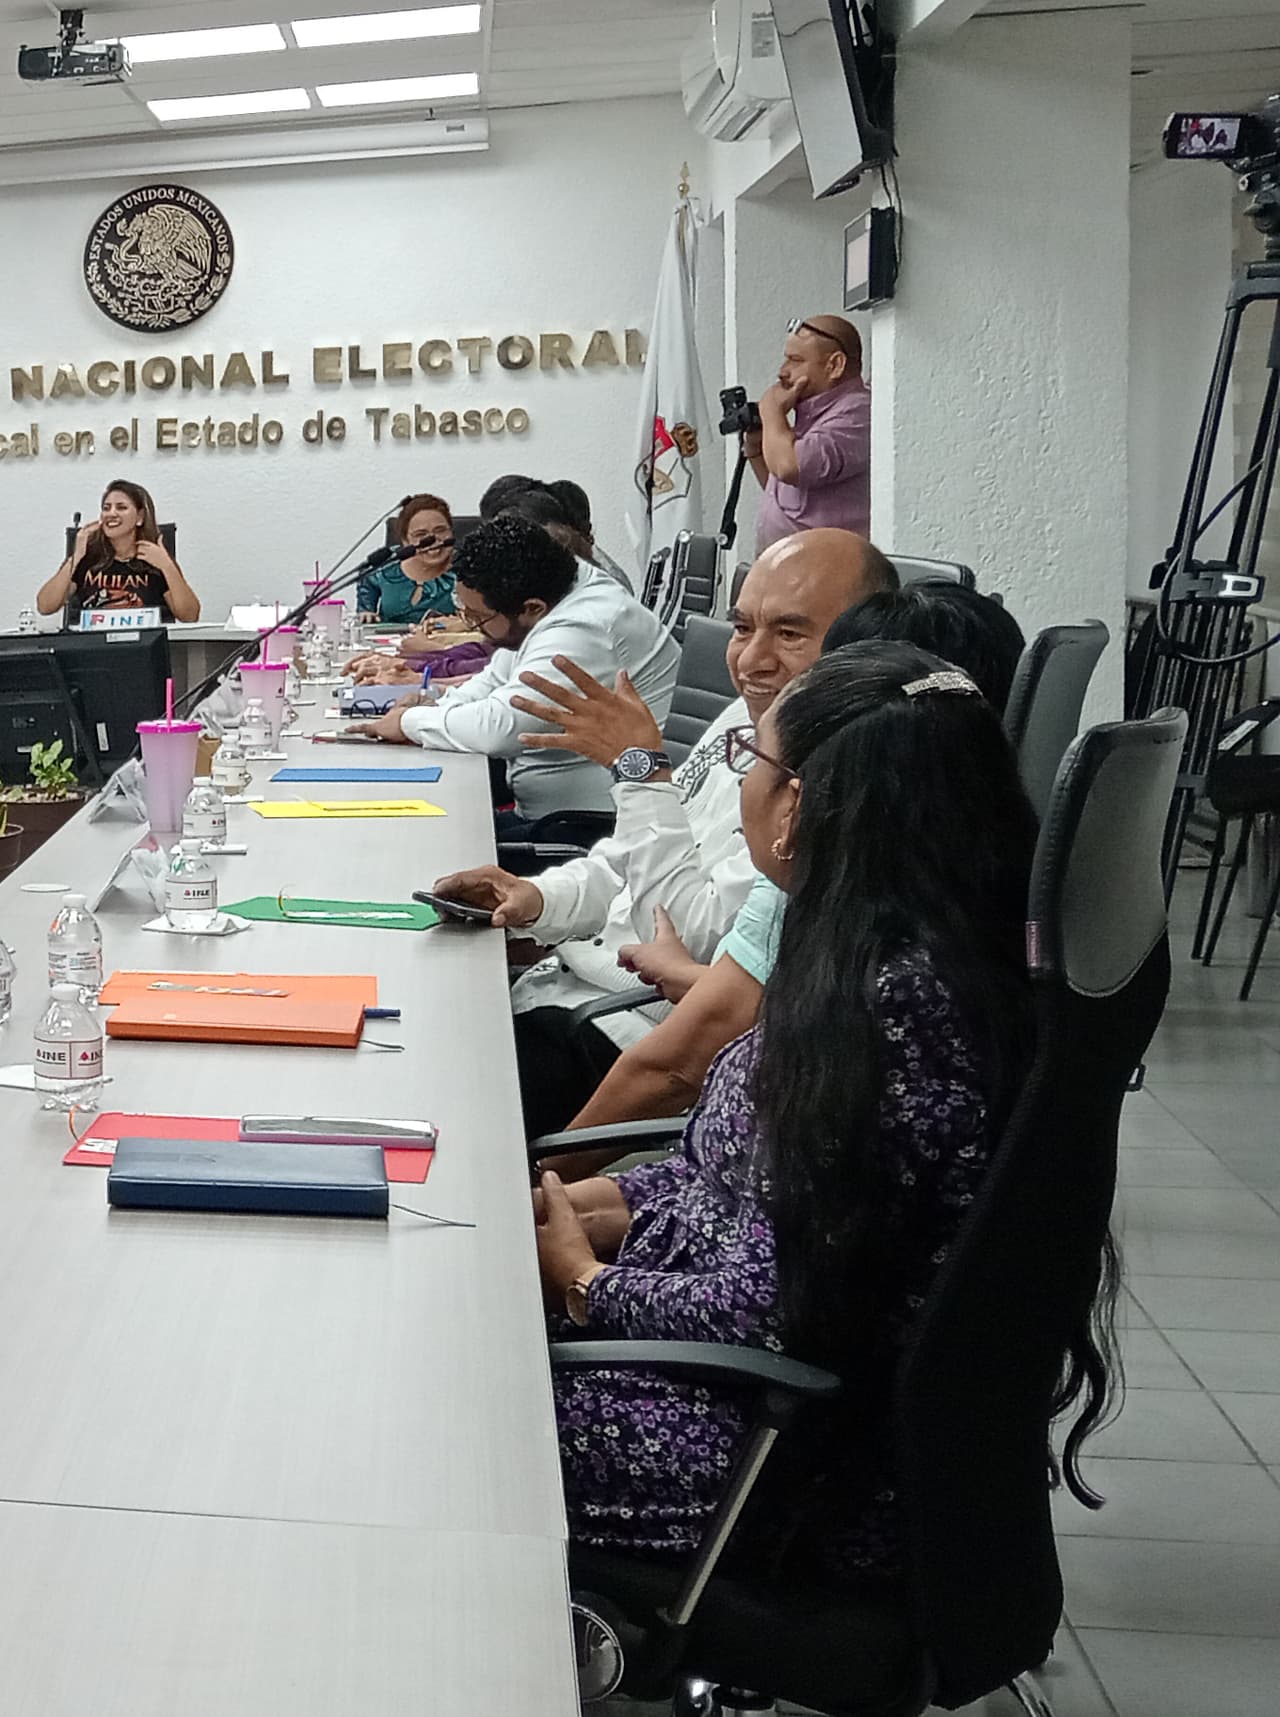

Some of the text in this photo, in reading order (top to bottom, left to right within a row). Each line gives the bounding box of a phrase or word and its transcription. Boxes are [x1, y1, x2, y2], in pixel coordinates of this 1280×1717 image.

[89, 187, 229, 260] ESTADOS UNIDOS MEXICANOS
[10, 350, 289, 402] NACIONAL
[312, 328, 646, 385] ELECTORAL
[54, 427, 95, 456] en
[109, 418, 139, 452] el
[156, 412, 284, 450] Estado
[302, 410, 346, 444] de
[365, 404, 530, 441] Tabasco
[84, 569, 149, 588] MULAN
[110, 615, 145, 626] INE
